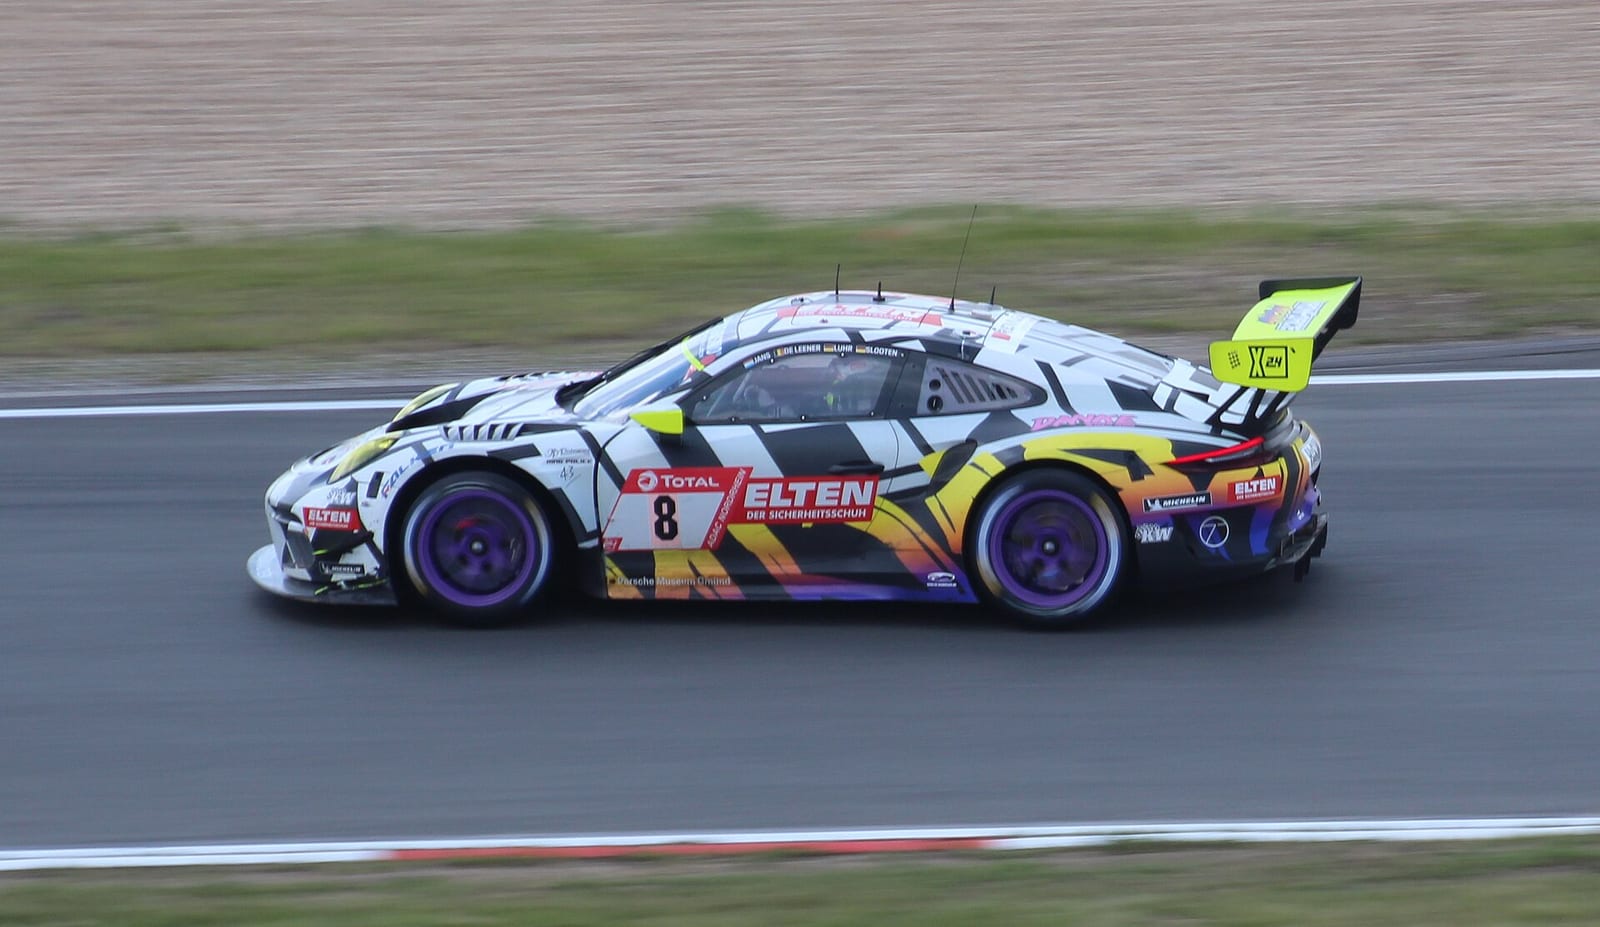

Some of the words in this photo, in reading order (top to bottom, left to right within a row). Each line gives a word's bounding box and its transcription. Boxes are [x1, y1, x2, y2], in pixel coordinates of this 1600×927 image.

[784, 347, 794, 355] DE
[795, 344, 821, 354] LEENER
[833, 344, 853, 353] LUHR
[865, 346, 898, 357] SLOOTEN
[753, 352, 771, 364] JANS
[660, 474, 719, 488] TOTAL
[1235, 478, 1276, 495] ELTEN
[744, 480, 874, 508] ELTEN
[707, 521, 723, 548] ADAC
[718, 468, 747, 523] NORDRHEIN
[1163, 495, 1206, 508] MICHELIN
[308, 509, 351, 523] ELTEN
[654, 495, 678, 541] 8
[746, 510, 766, 520] DER
[769, 508, 867, 520] SICHERHEITSSCHUH
[656, 576, 696, 586] Museum
